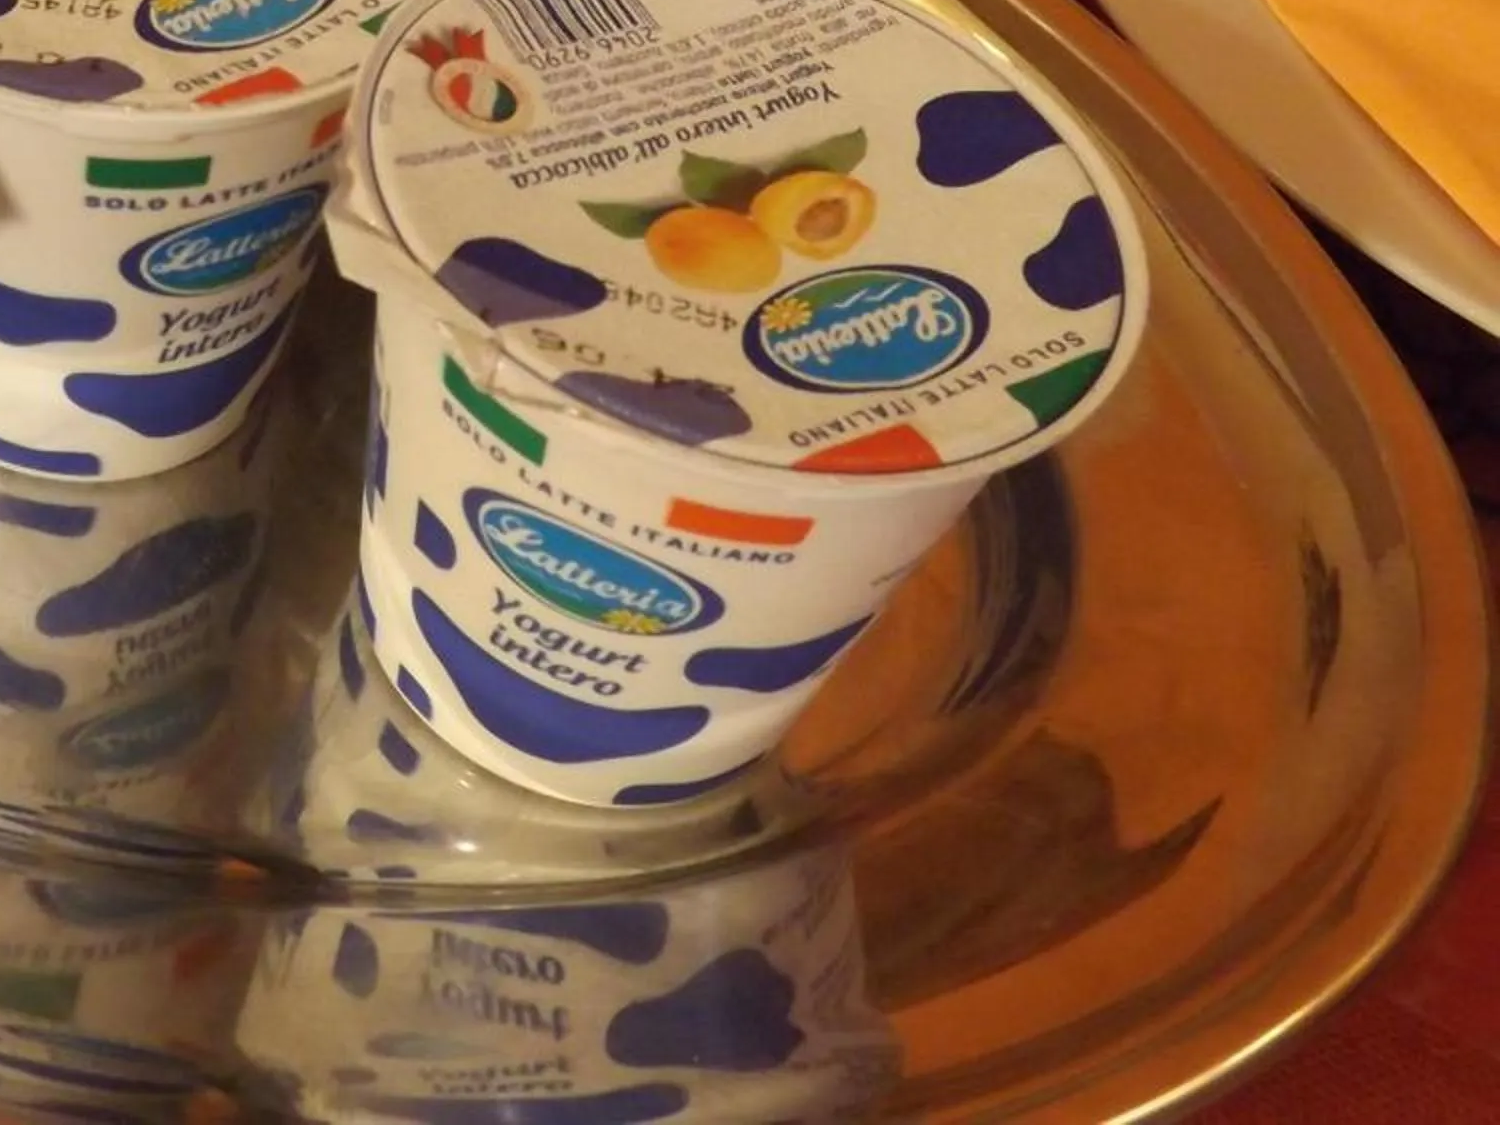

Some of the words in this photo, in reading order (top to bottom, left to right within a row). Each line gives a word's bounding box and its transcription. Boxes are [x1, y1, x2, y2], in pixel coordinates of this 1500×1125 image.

[287, 6, 360, 51] LATTE
[596, 21, 659, 53] 2046
[174, 41, 283, 94] ITALIANO
[526, 36, 591, 79] 9290
[675, 110, 752, 142] intero
[752, 82, 840, 120] Yogurt
[510, 134, 670, 189] all'albicocca
[84, 193, 168, 212] SOLO
[180, 179, 269, 210] LATTE
[159, 278, 281, 336] Yogurt
[775, 286, 959, 364] Latteria
[158, 313, 267, 364] intero
[1001, 329, 1087, 381] SOLO
[909, 361, 1000, 416] LATTE
[789, 393, 915, 450] ITALIANO
[441, 400, 507, 464] SOLO
[518, 466, 615, 528] LATTE
[631, 523, 796, 565] ITALIANO
[485, 514, 689, 623] Latteria
[491, 589, 650, 674] Yogurt
[489, 627, 623, 698] intero
